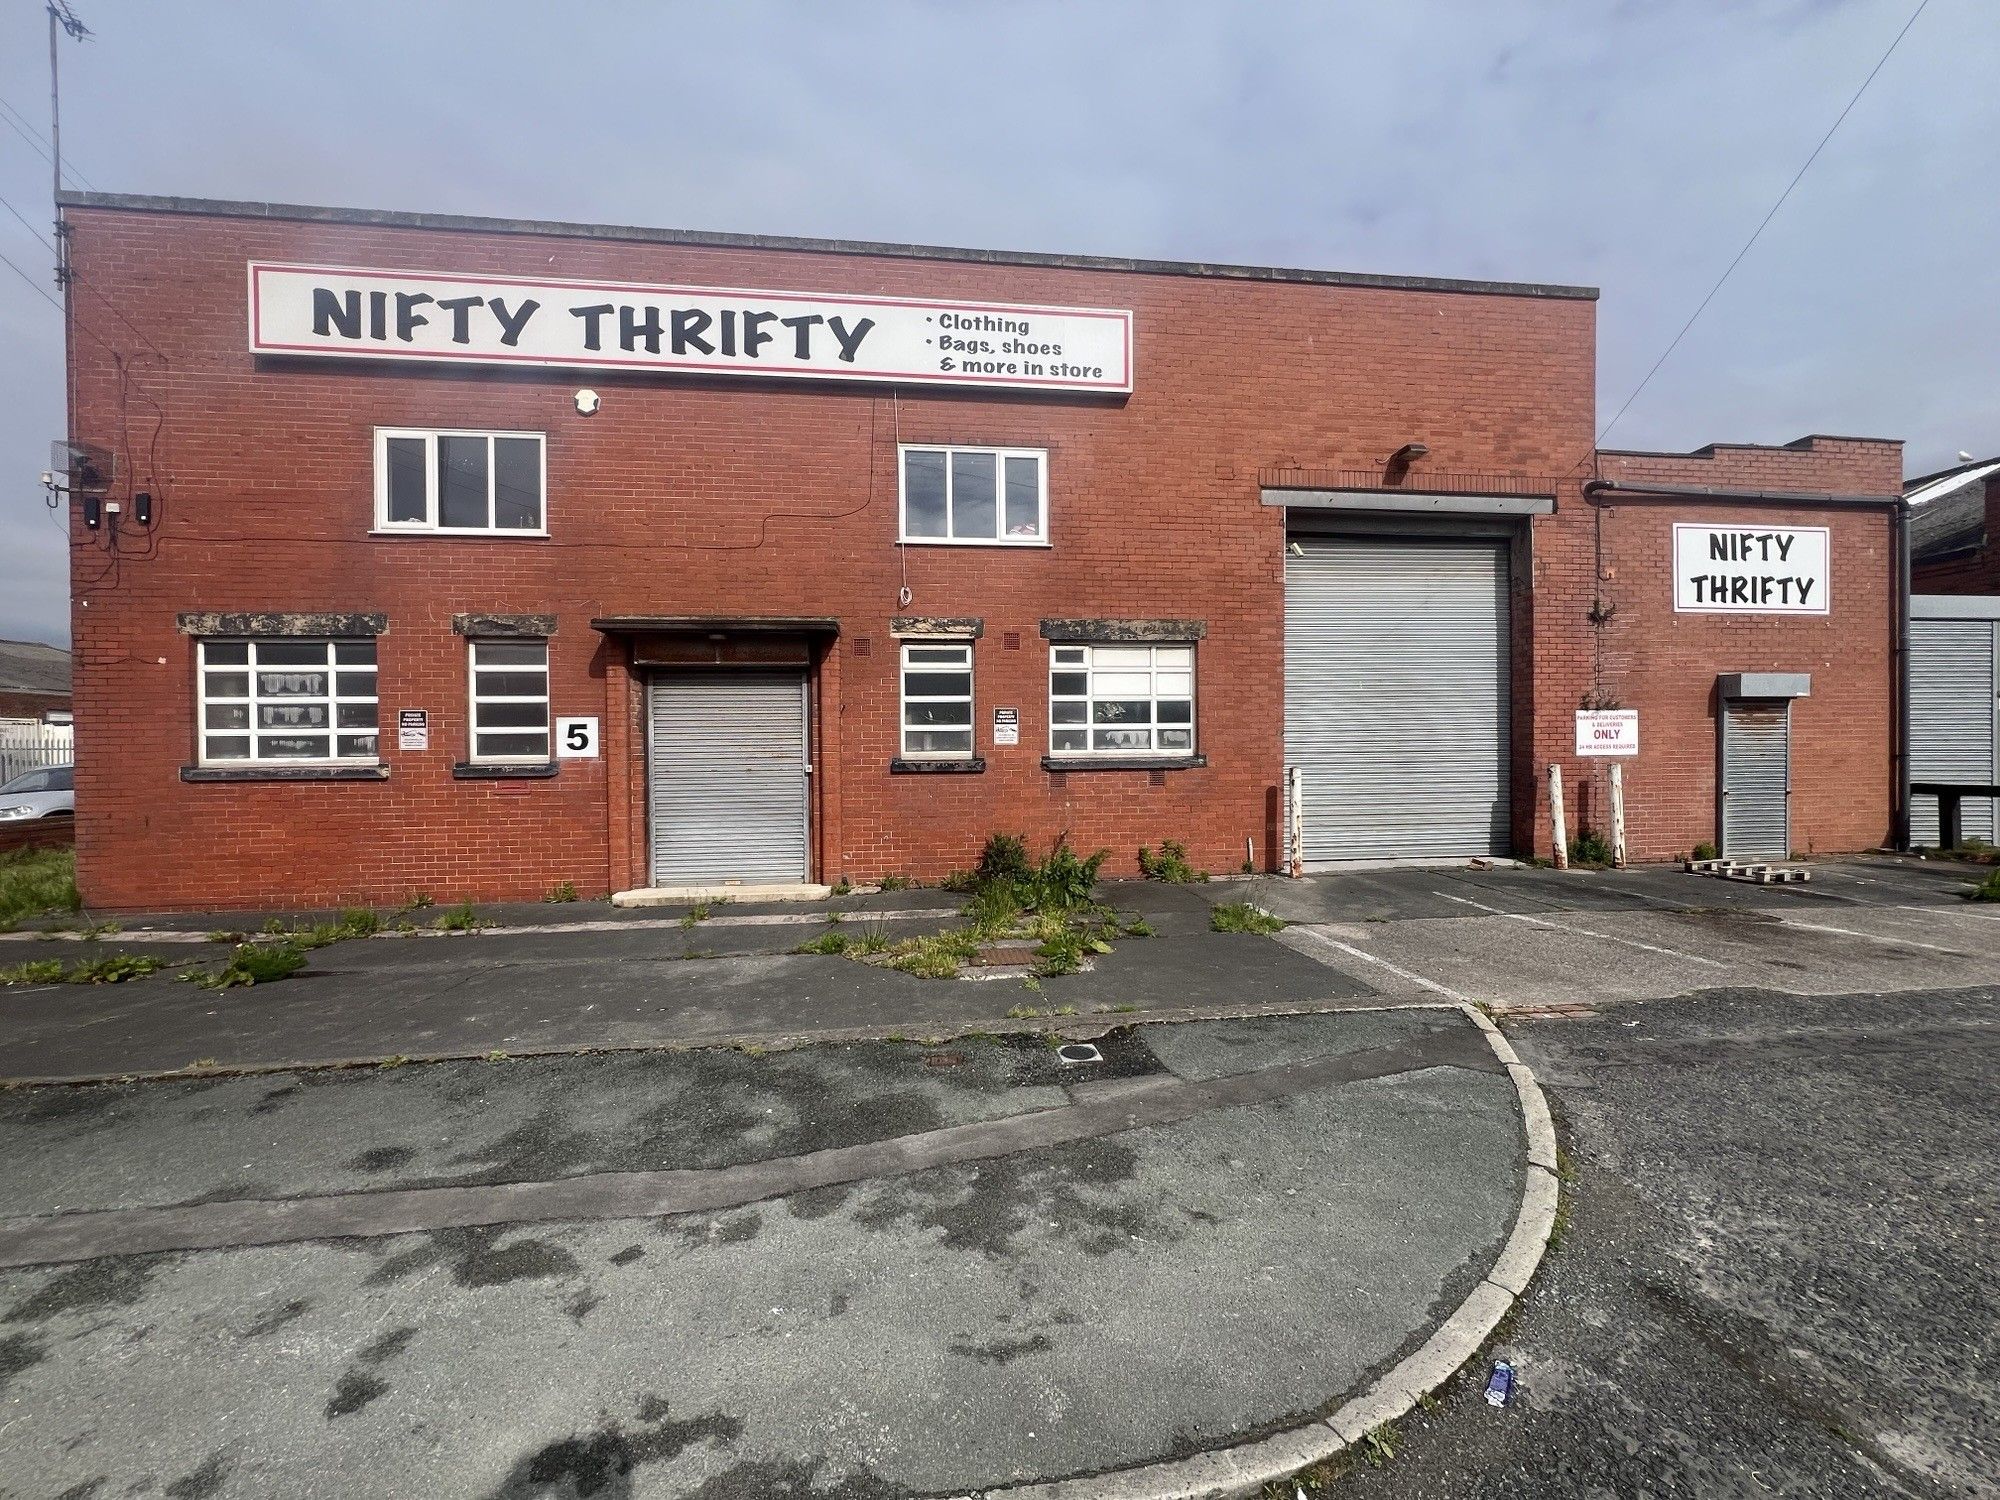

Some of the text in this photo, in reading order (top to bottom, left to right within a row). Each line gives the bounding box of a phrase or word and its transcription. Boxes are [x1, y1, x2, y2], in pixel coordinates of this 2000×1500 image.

[312, 288, 875, 362] NIFTY THRIFTY
[939, 313, 1030, 336] Clothing
[939, 335, 1062, 356] Bags, shoes
[940, 357, 1103, 378] & more in store
[1709, 533, 1795, 561] NIFTY
[1690, 575, 1815, 605] THRIFTY
[566, 723, 589, 750] 5
[1594, 729, 1620, 739] ONLY
